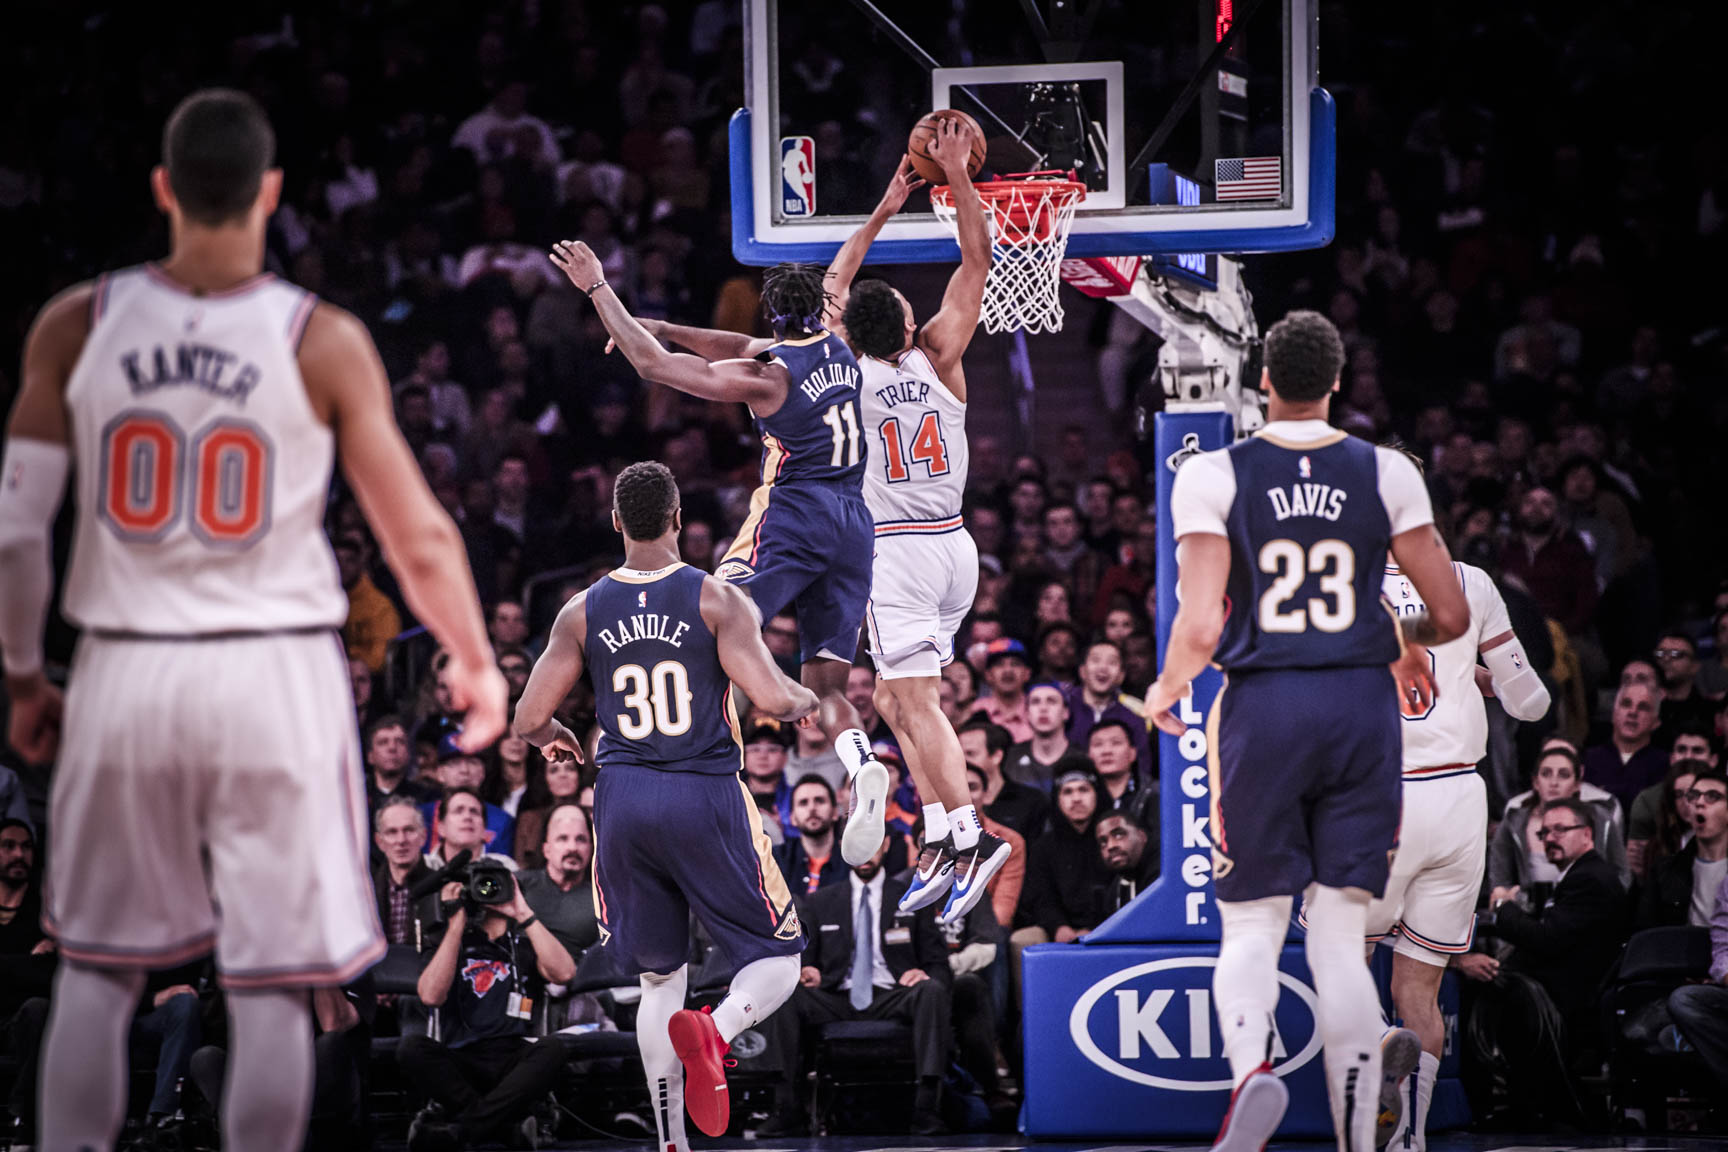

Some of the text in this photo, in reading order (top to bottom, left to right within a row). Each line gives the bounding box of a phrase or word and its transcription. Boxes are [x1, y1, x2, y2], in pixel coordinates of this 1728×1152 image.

[785, 199, 803, 213] NBA
[120, 342, 262, 406] KANTER
[800, 363, 859, 402] HOLIDAY
[875, 381, 930, 409] TRIER
[822, 400, 860, 467] 11
[878, 410, 951, 484] 14
[98, 406, 276, 551] 00
[1267, 483, 1347, 521] DAVIS
[1258, 538, 1356, 633] 23
[598, 613, 691, 654] RANDLE
[612, 660, 693, 740] 30
